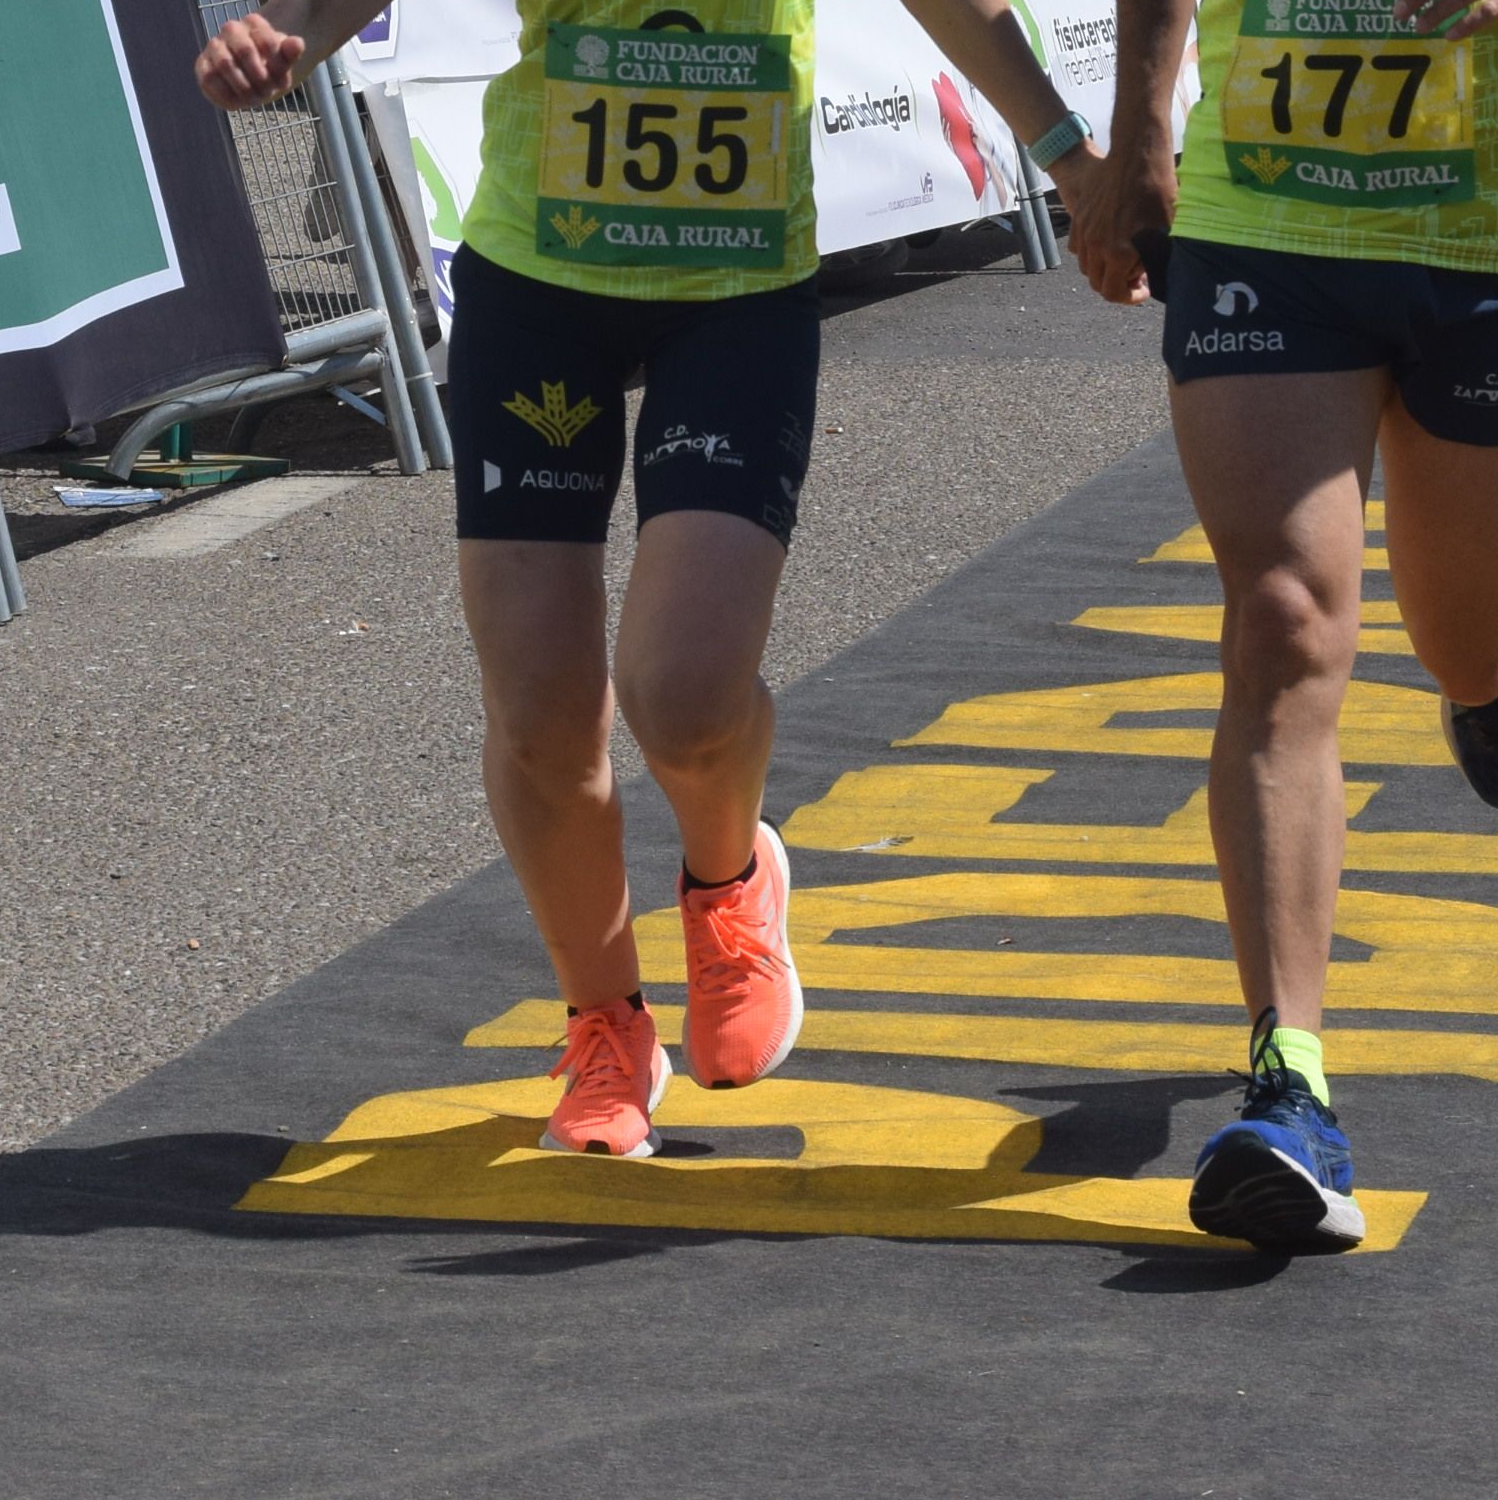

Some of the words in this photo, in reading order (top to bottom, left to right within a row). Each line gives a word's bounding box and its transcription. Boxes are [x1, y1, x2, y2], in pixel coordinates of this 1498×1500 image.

[1295, 14, 1349, 34] CAJA
[616, 40, 757, 65] FUNDACION
[616, 62, 672, 83] CAJA
[679, 66, 757, 85] RURAL
[1260, 52, 1431, 138] 177
[571, 97, 748, 195] 155
[1295, 162, 1360, 191] CAJA
[1365, 164, 1459, 192] RURAL
[603, 222, 670, 246] CAJA
[677, 225, 769, 249] RURAL
[1185, 327, 1285, 357] Adarsa
[664, 425, 689, 440] C.D.
[519, 469, 606, 491] AQUONA
